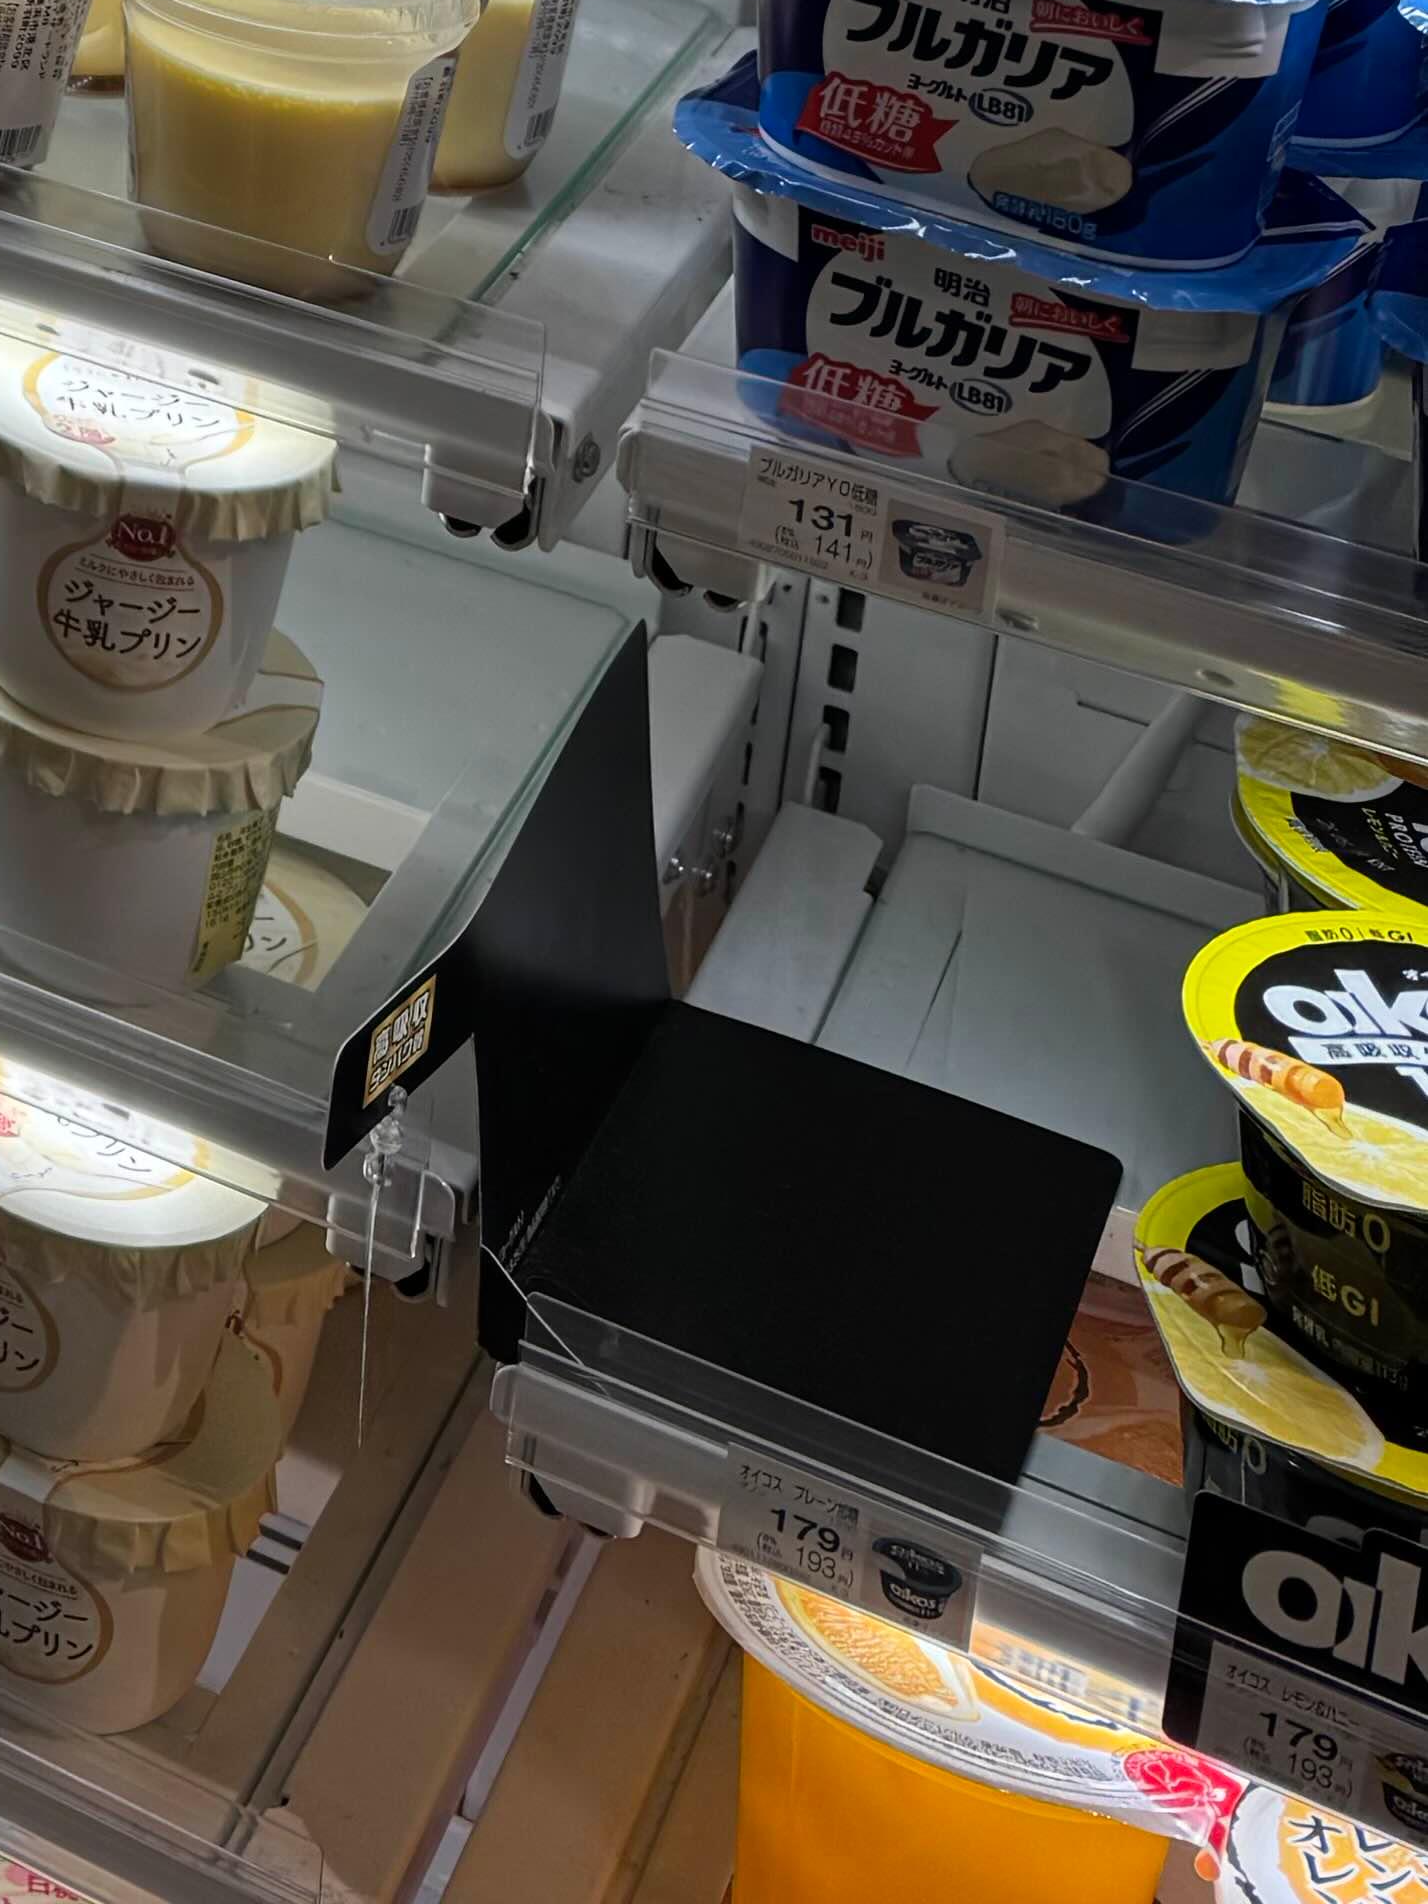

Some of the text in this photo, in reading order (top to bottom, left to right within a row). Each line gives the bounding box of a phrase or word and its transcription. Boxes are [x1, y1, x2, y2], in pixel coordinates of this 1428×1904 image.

[818, 75, 923, 144] 低糖
[907, 75, 1028, 122] ヨーグルト LB81
[810, 223, 886, 264] meiji
[934, 266, 1125, 336] 明治 朝においしく
[827, 271, 1093, 396] ブルガリア
[801, 359, 908, 414] 低糖
[888, 358, 1007, 414] ヨーグルト LB81
[115, 514, 174, 550] No.1
[62, 577, 203, 622] ジャージー
[51, 608, 204, 662] 牛乳プリン
[1301, 1178, 1393, 1256] 脂肪0
[1310, 1264, 1382, 1328] 低GI
[740, 1464, 784, 1492] オイコス
[1224, 1664, 1271, 1693] オイコス
